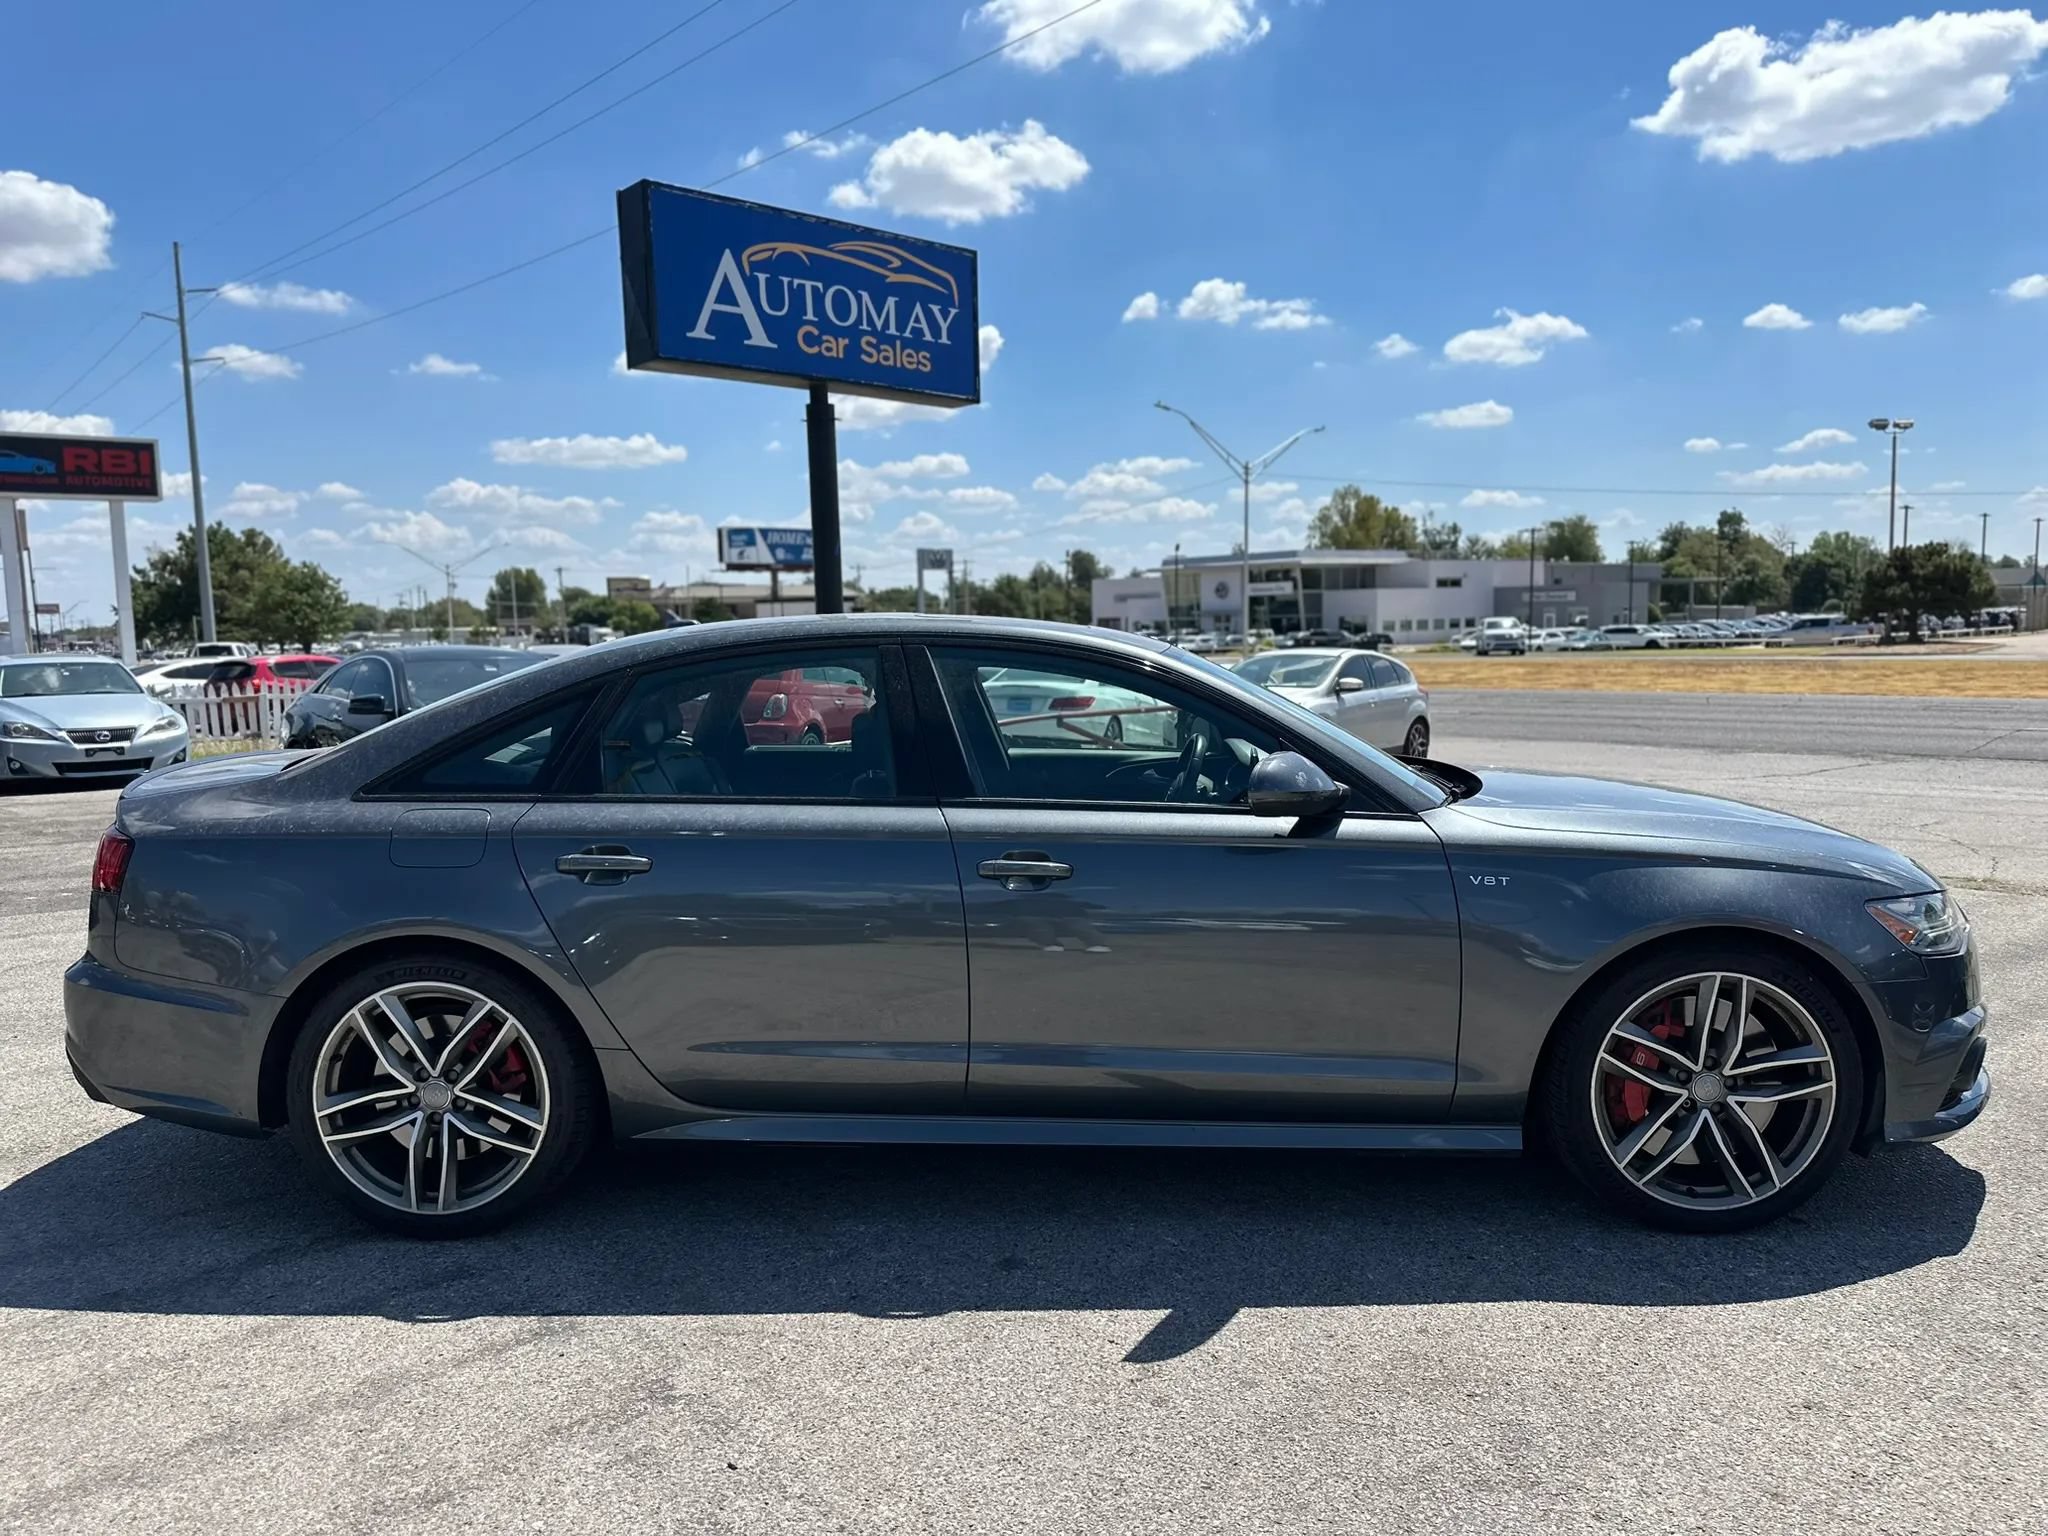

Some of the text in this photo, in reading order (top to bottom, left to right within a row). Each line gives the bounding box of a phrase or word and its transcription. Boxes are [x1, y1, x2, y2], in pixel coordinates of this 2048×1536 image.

[685, 248, 959, 349] AUTOMAY
[797, 325, 932, 372] Car Sales
[62, 446, 150, 475] RBI
[65, 475, 152, 488] AUTOMOTIVE
[1469, 875, 1510, 886] V8T
